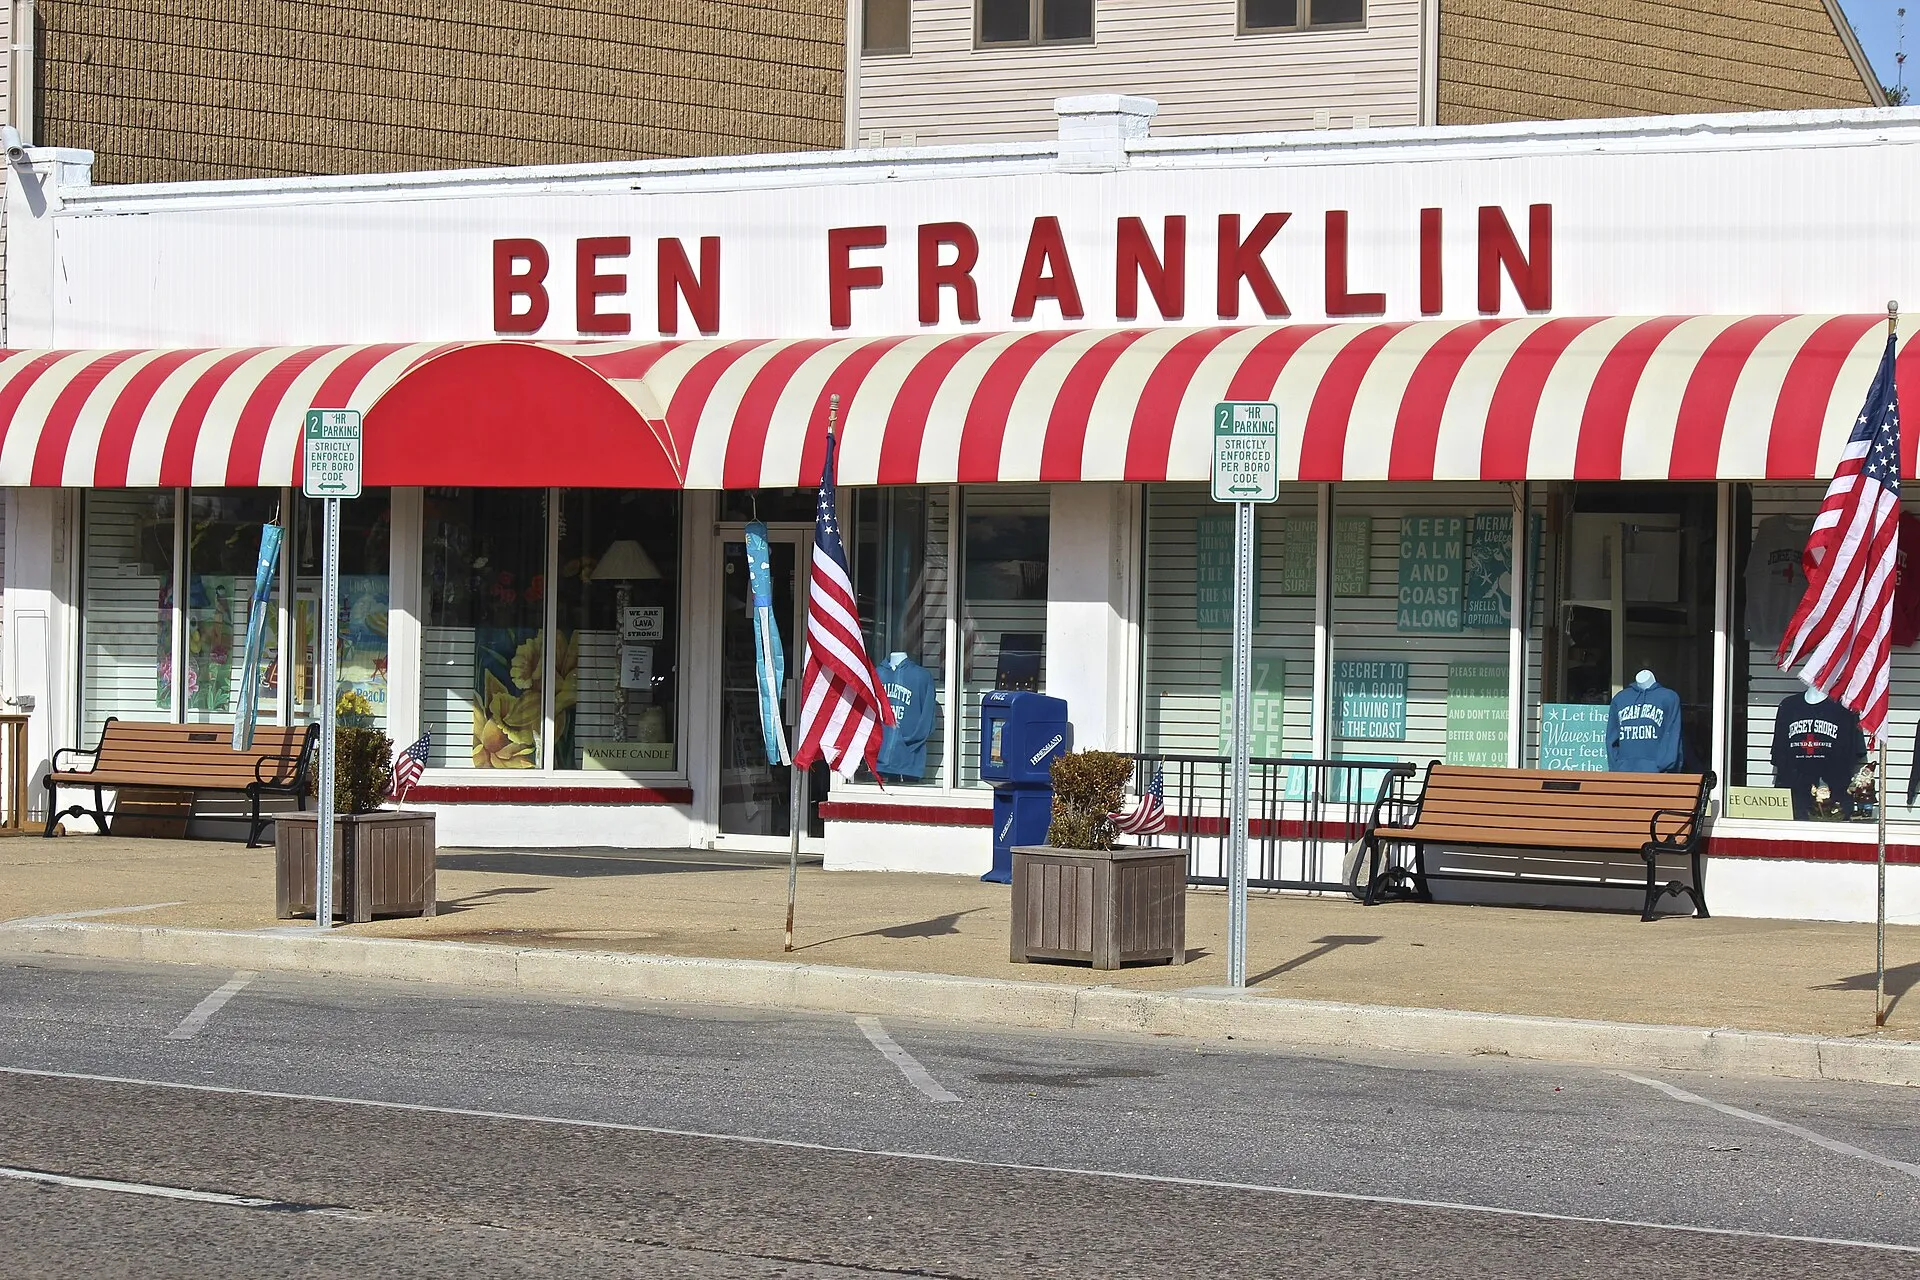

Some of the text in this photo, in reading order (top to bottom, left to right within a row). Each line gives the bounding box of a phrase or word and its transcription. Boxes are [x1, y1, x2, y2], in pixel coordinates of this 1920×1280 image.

[493, 203, 1552, 336] BEN FRANKLIN
[335, 413, 346, 424] HR
[1248, 406, 1261, 419] HR
[310, 416, 319, 433] 2
[1220, 410, 1229, 429] 2
[323, 426, 358, 437] PARKING
[1234, 420, 1275, 433] PARKING
[315, 442, 351, 451] STRICTLY
[1225, 440, 1267, 449] STRICTLY
[311, 452, 355, 461] ENFORCED
[1220, 451, 1271, 460] ENFORCED
[311, 462, 354, 471] PER BORO
[1221, 462, 1270, 472] PER BORO
[321, 472, 344, 481] CODE
[1233, 473, 1258, 483] CODE
[1401, 518, 1461, 537] KEEP
[1401, 541, 1460, 559] CALM
[1410, 564, 1449, 582] AND
[1200, 588, 1219, 602] THE
[1400, 586, 1459, 605] COAST
[1468, 601, 1497, 611] SHELLS
[635, 619, 653, 627] LAVA
[1399, 609, 1458, 628] ALONG
[1468, 614, 1503, 625] OPTIONAL
[1341, 662, 1386, 679] SECRET
[1390, 663, 1404, 679] TO
[1450, 667, 1509, 678] PLEASE REMOV
[1360, 682, 1367, 698] A
[1371, 682, 1404, 699] GOOD
[1449, 688, 1475, 698] YOUR
[1222, 697, 1280, 732] BEE
[1340, 701, 1350, 717] IS
[1353, 701, 1388, 718] LIVING
[1392, 702, 1403, 719] IT
[1449, 709, 1465, 719] AND
[1467, 709, 1490, 720] DON'T
[1562, 707, 1609, 722] Let the
[1348, 720, 1367, 738] THE
[1369, 721, 1402, 739] COAST
[1448, 730, 1474, 741] BETTER
[1476, 731, 1496, 741] ONES
[1543, 721, 1592, 746] Waves
[1788, 719, 1839, 740] JERSEY SHORE
[587, 749, 670, 759] YANKEE CANDLE
[1447, 751, 1464, 762] THE
[1467, 751, 1487, 762] WAY
[1544, 747, 1575, 759] your
[1581, 761, 1603, 772] the
[1743, 794, 1789, 808] CANDLE
